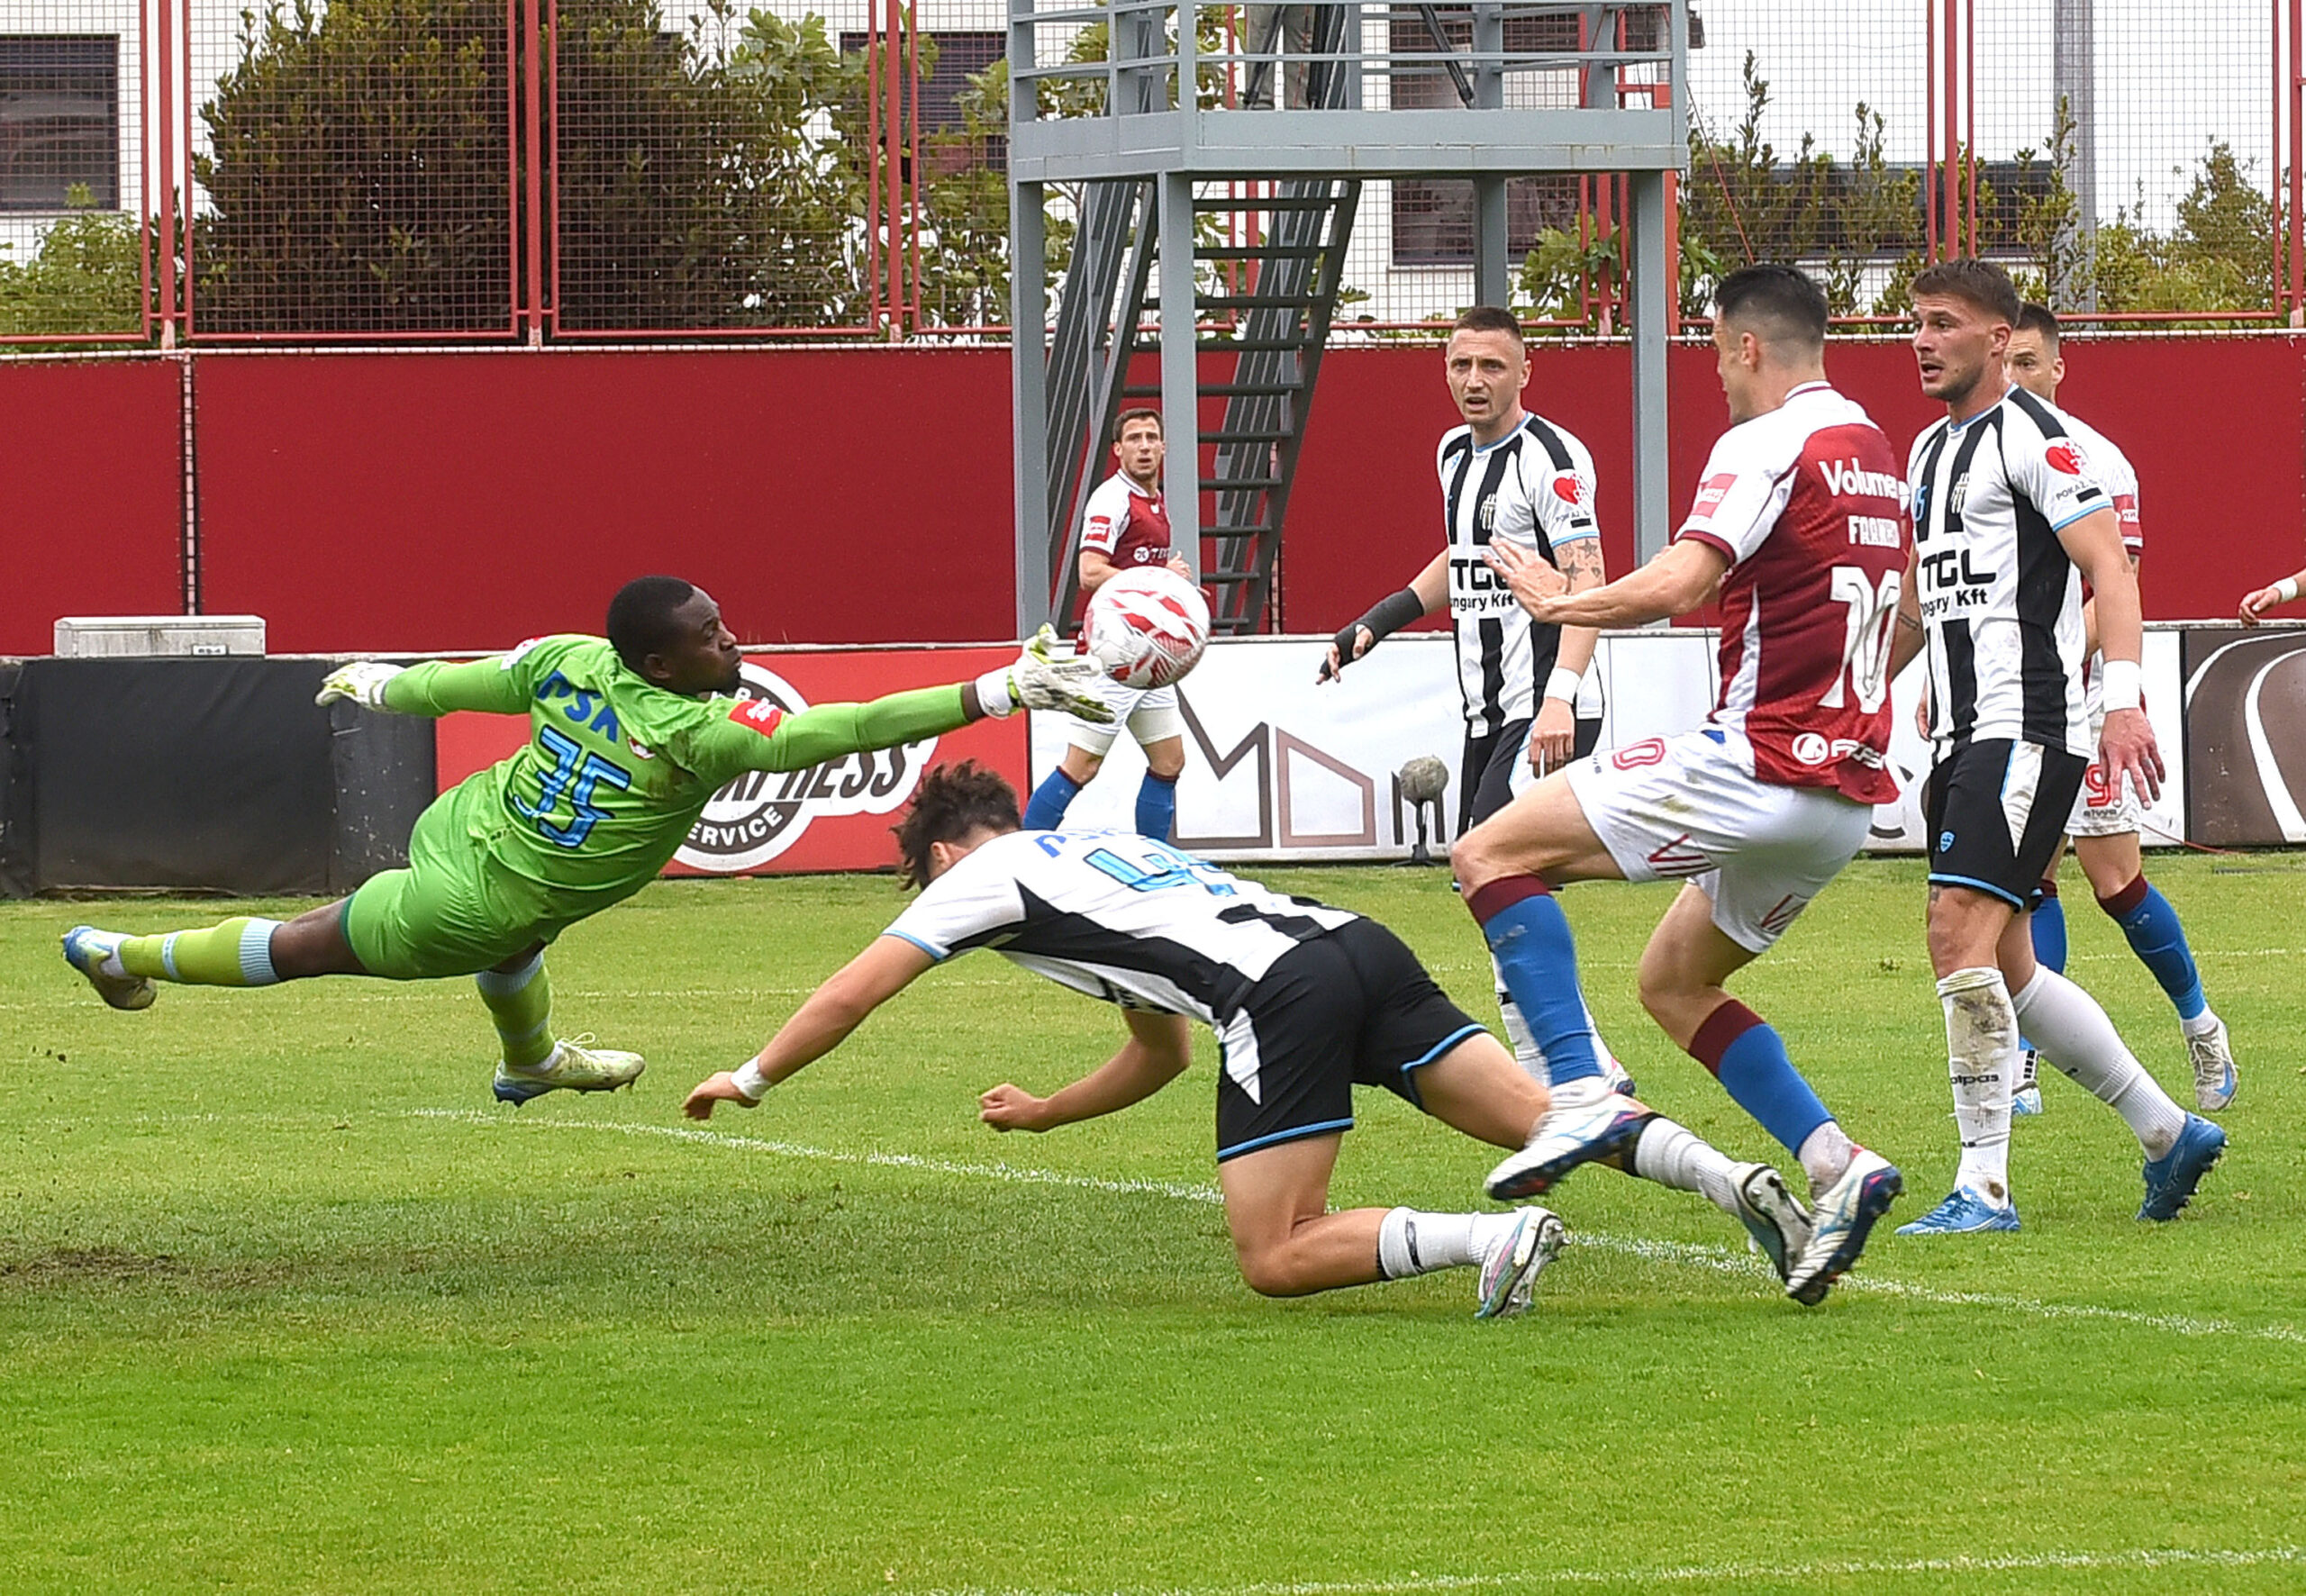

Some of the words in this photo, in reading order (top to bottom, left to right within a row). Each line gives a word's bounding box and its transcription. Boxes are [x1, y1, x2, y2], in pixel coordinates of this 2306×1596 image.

[1921, 549, 1997, 593] TGL
[1956, 588, 1988, 607] Kft
[513, 723, 632, 848] 35
[687, 805, 784, 847] ERVICE
